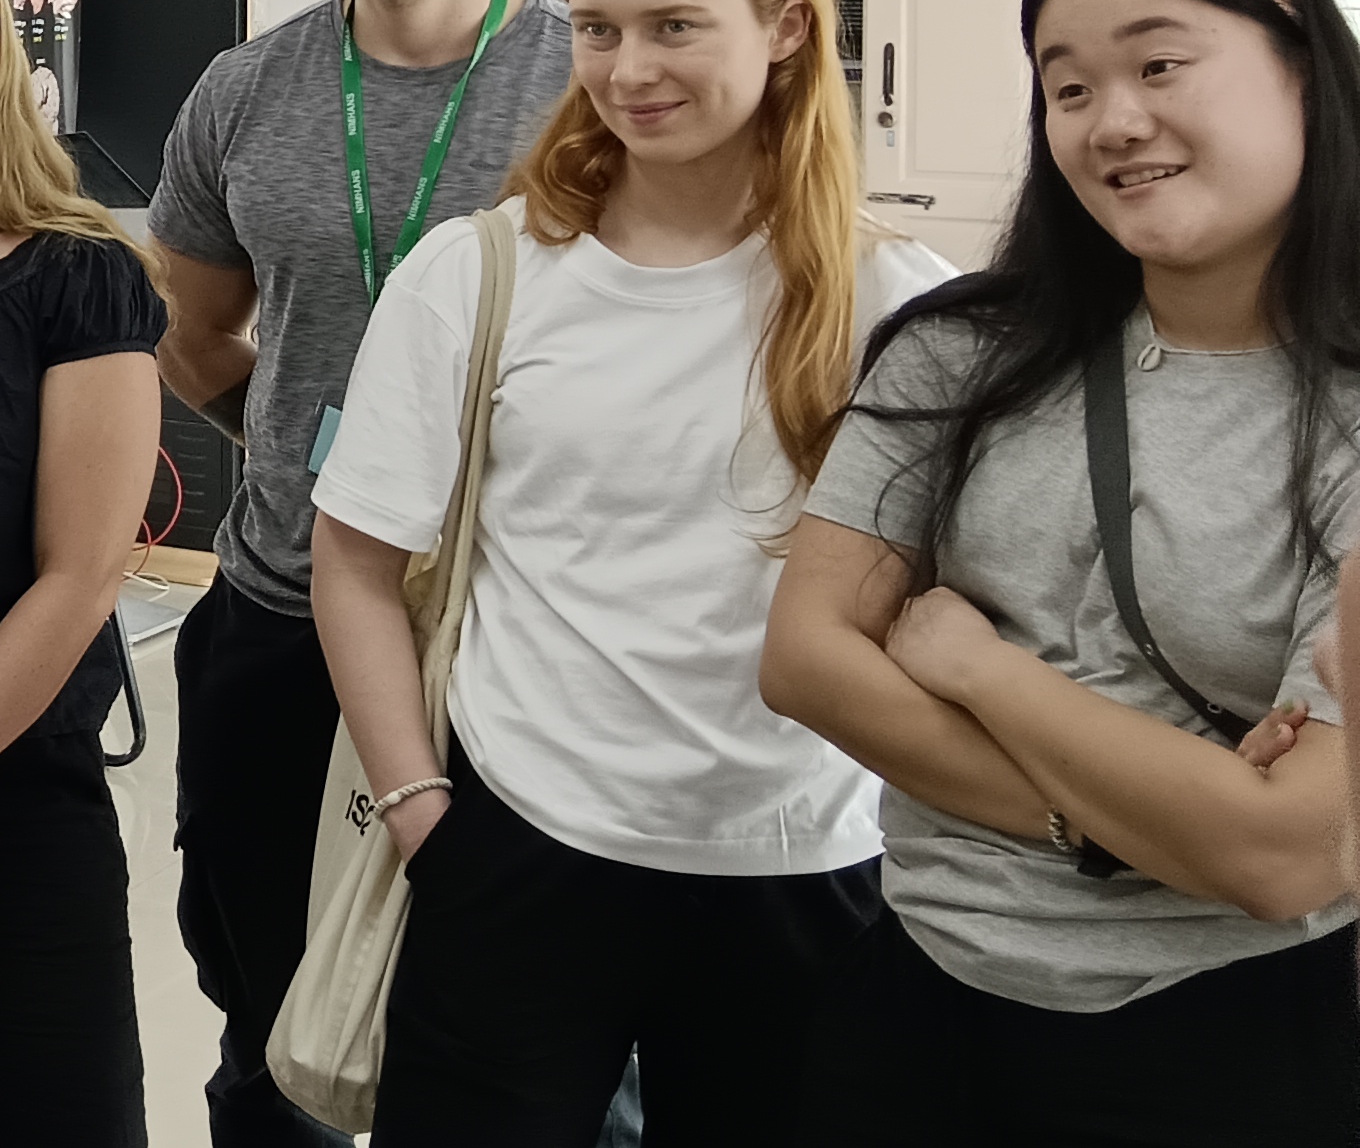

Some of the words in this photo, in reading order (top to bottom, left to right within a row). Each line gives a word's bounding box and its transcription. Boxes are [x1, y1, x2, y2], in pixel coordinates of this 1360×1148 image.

[347, 93, 357, 137] NIMHANS
[433, 101, 455, 143] NIMHANS
[351, 169, 365, 213] NIMHANS
[407, 177, 428, 221] NIMHANS
